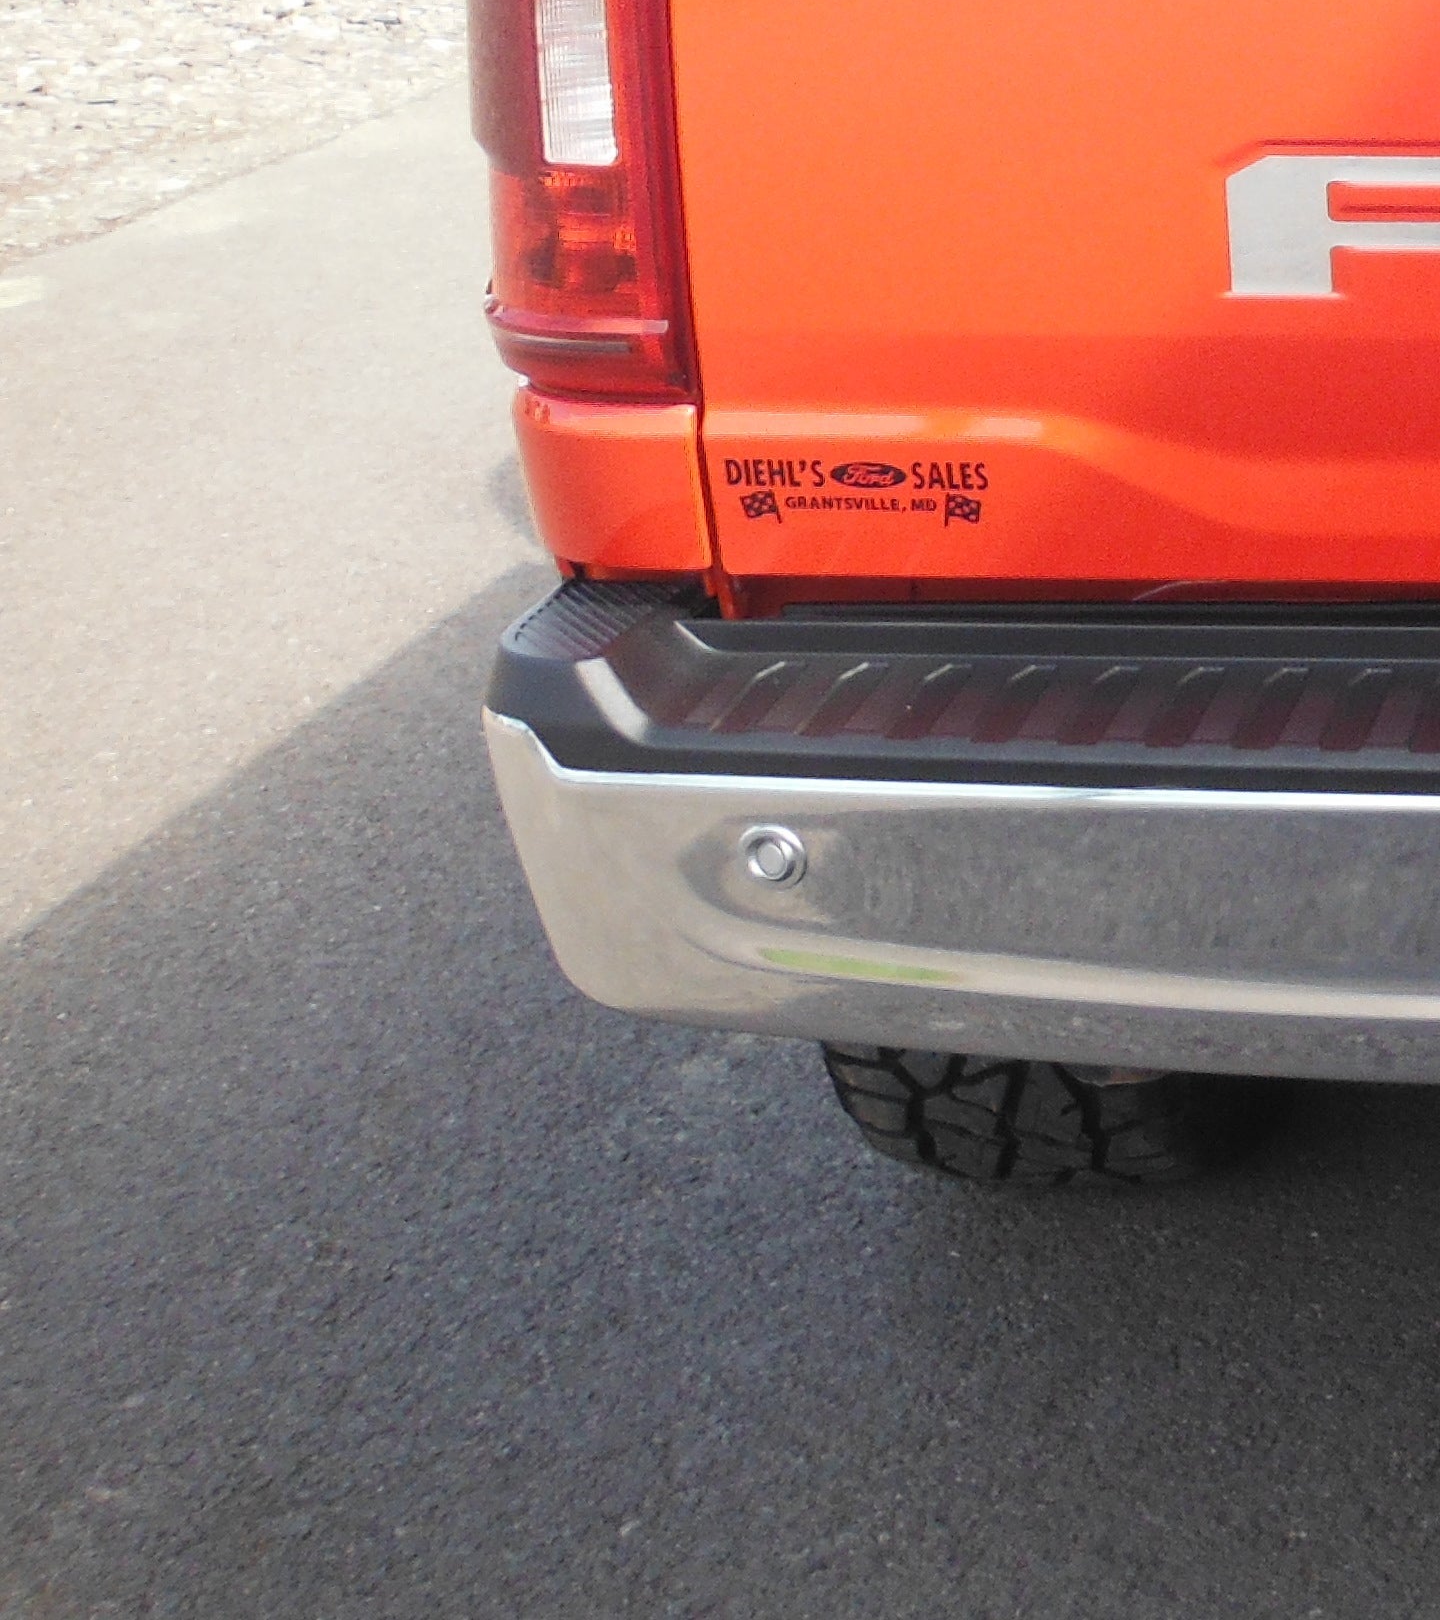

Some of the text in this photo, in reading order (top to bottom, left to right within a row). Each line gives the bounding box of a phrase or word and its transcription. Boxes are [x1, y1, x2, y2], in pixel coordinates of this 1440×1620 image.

[724, 458, 826, 488] DIEHL'S
[911, 461, 989, 490] SALES
[784, 495, 938, 513] GRANTSVILLE, MD
